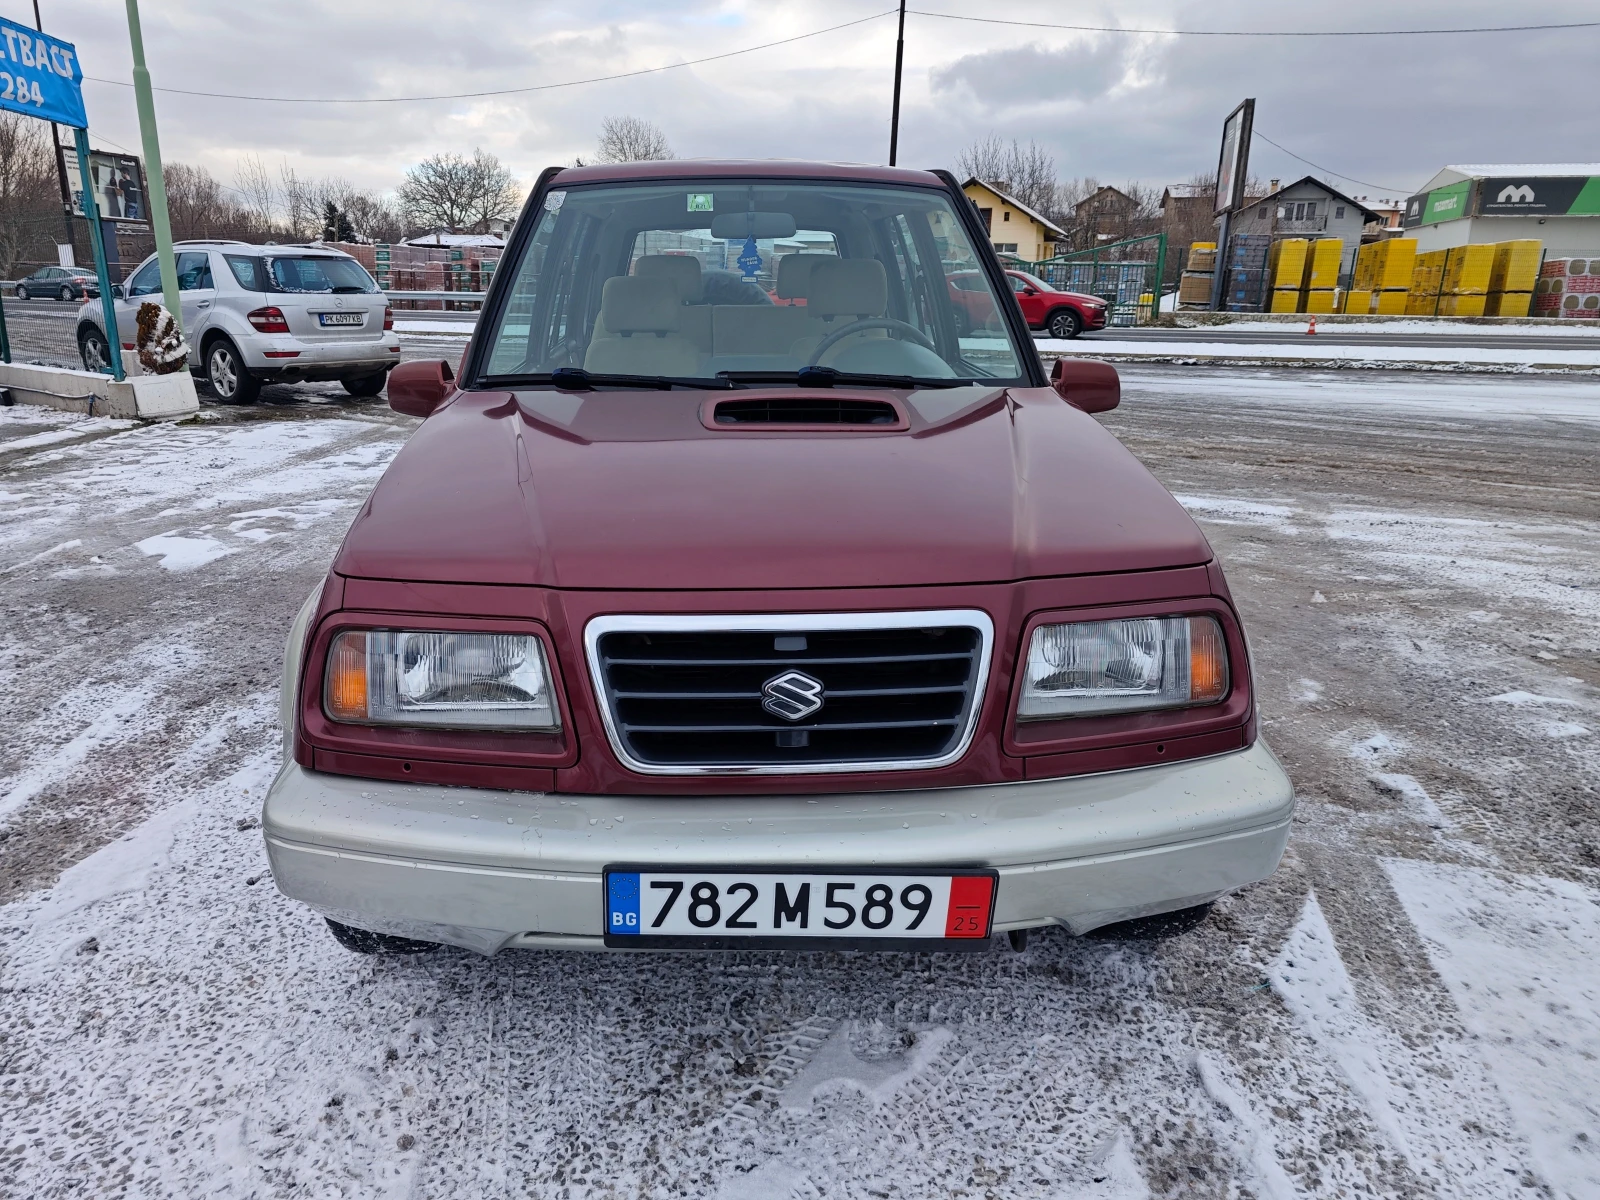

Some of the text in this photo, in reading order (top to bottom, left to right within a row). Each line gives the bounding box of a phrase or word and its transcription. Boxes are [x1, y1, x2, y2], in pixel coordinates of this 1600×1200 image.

[0, 26, 74, 80] ТВАСТ
[0, 71, 44, 107] 284
[612, 911, 637, 926] BG
[953, 916, 979, 931] 25
